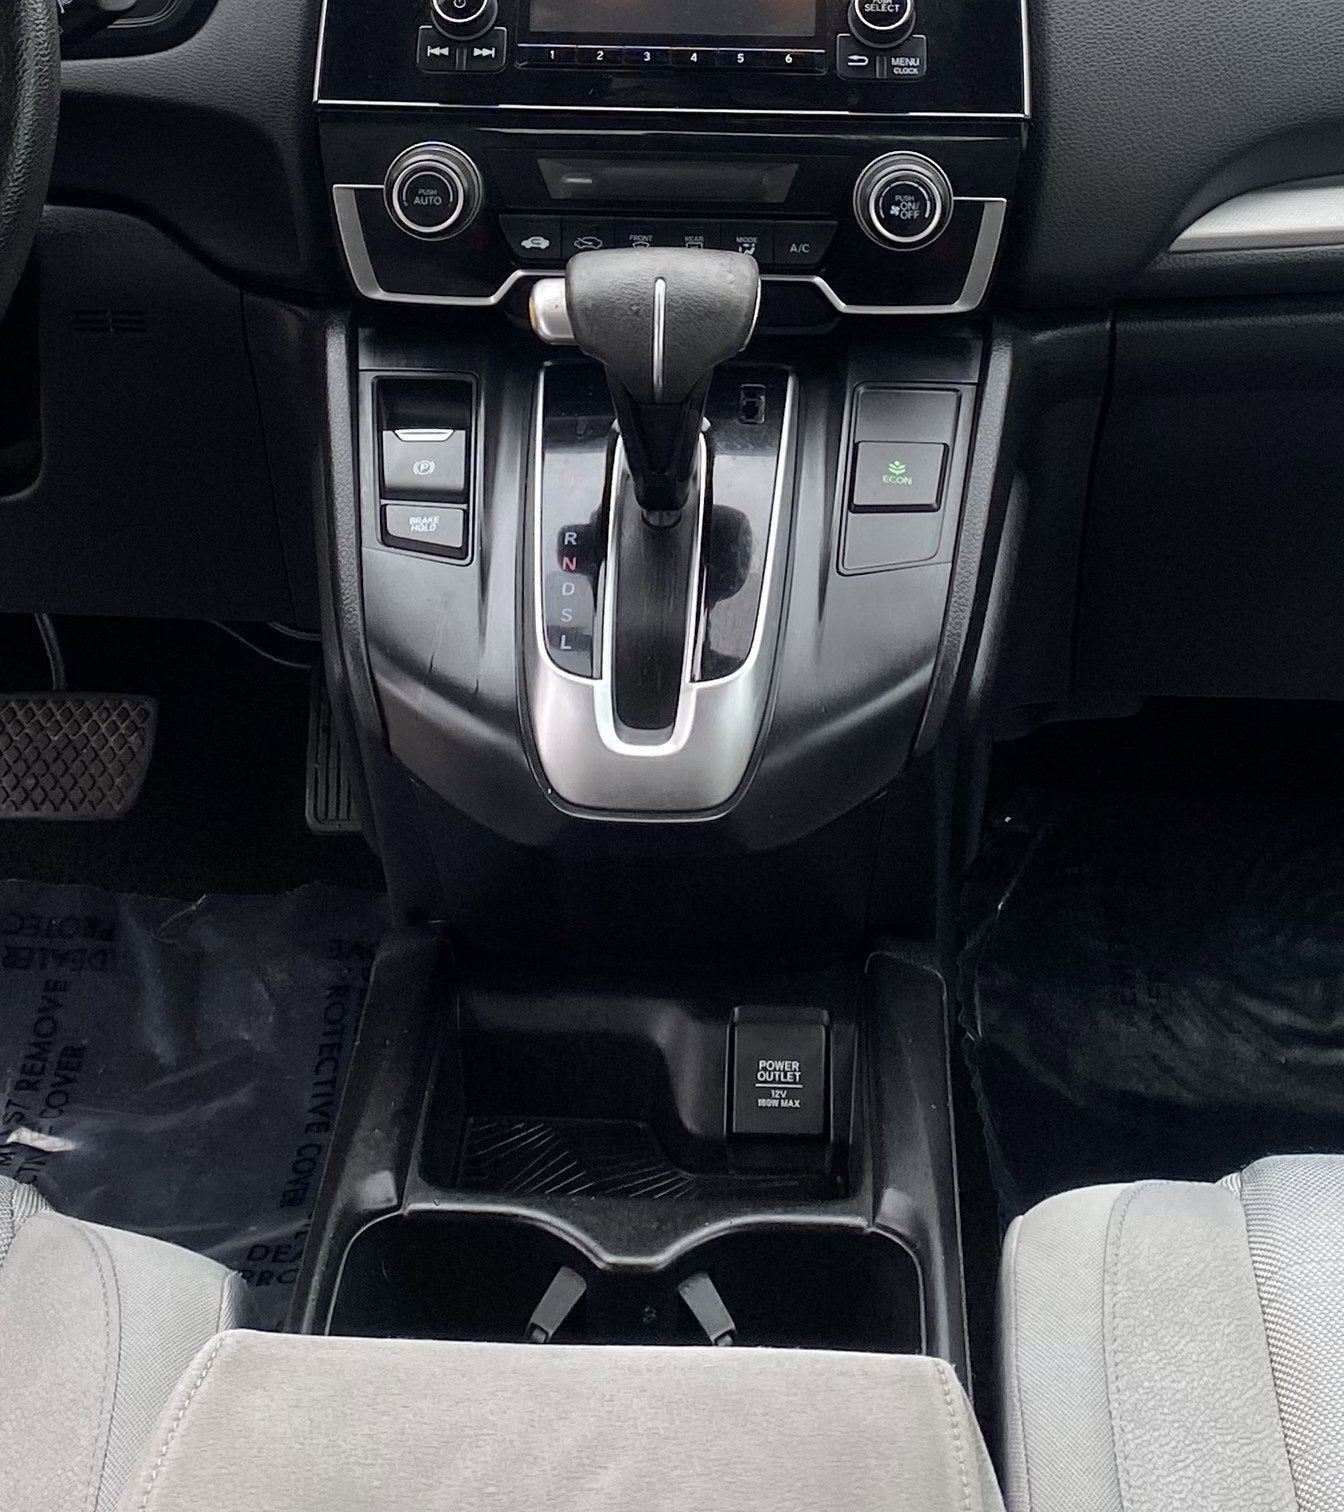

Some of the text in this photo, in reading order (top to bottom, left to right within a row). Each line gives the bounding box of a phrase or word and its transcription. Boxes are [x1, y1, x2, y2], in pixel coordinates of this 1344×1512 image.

[864, 3, 900, 13] SELECT
[595, 51, 603, 60] 2
[643, 51, 651, 61] 3
[689, 52, 698, 62] 4
[736, 53, 744, 63] 5
[784, 54, 793, 64] 6
[891, 57, 920, 66] MENU
[893, 67, 919, 75] CLOCK
[413, 196, 442, 206] AUTO
[900, 201, 920, 210] ON/
[900, 211, 920, 220] OFF
[736, 236, 758, 244] MODE
[789, 243, 810, 253] A/C
[881, 474, 913, 486] ECON
[409, 515, 440, 527] BRAKE
[410, 523, 438, 533] HOLD
[563, 531, 578, 546] R
[562, 556, 577, 571] N
[561, 582, 576, 596] D
[561, 608, 573, 623] S
[560, 635, 572, 649] L
[758, 1061, 800, 1071] POWER
[39, 1045, 88, 1120] COVER
[757, 1071, 802, 1083] OUTLET
[770, 1090, 788, 1099] 12V
[781, 1098, 801, 1108] MAX
